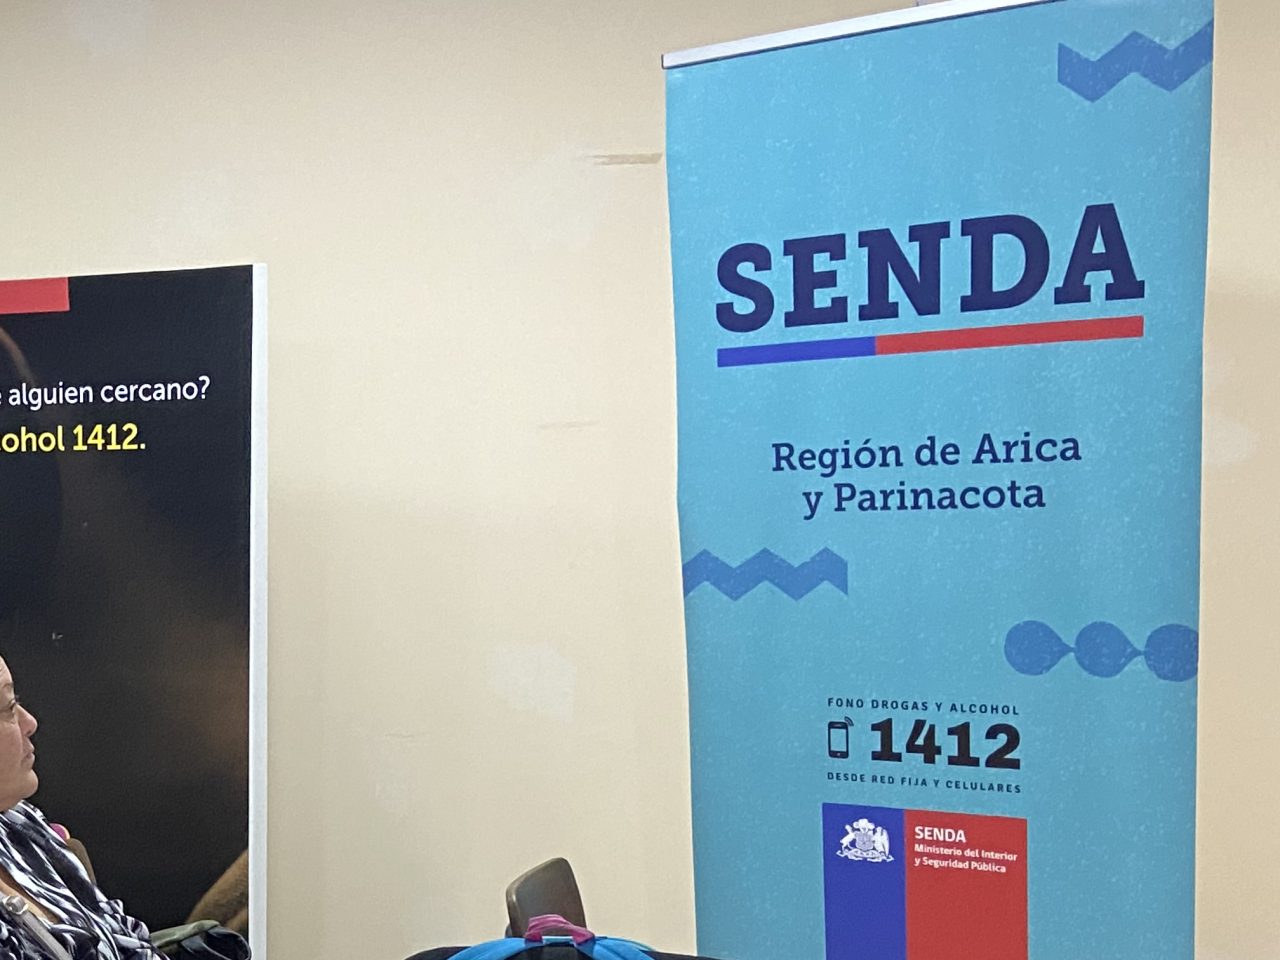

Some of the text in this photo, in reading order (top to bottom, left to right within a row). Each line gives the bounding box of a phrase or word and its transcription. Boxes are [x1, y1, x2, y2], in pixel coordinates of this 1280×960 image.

[716, 203, 1145, 332] SENDA
[8, 381, 94, 411] alguien
[99, 375, 212, 403] cercano?
[72, 422, 147, 451] 1412.
[771, 431, 1083, 478] Región de Arica
[802, 480, 1046, 521] y Parinacota
[827, 697, 1020, 716] FONO DROGAS Y ALCOHOL
[870, 717, 1022, 770] 1412
[827, 771, 1022, 794] DESDE RED FIJA Y CELULARES
[914, 825, 967, 843] SENDA
[913, 856, 1007, 873] y Seguridad Pública
[914, 843, 1018, 861] Ministerio del Interior
